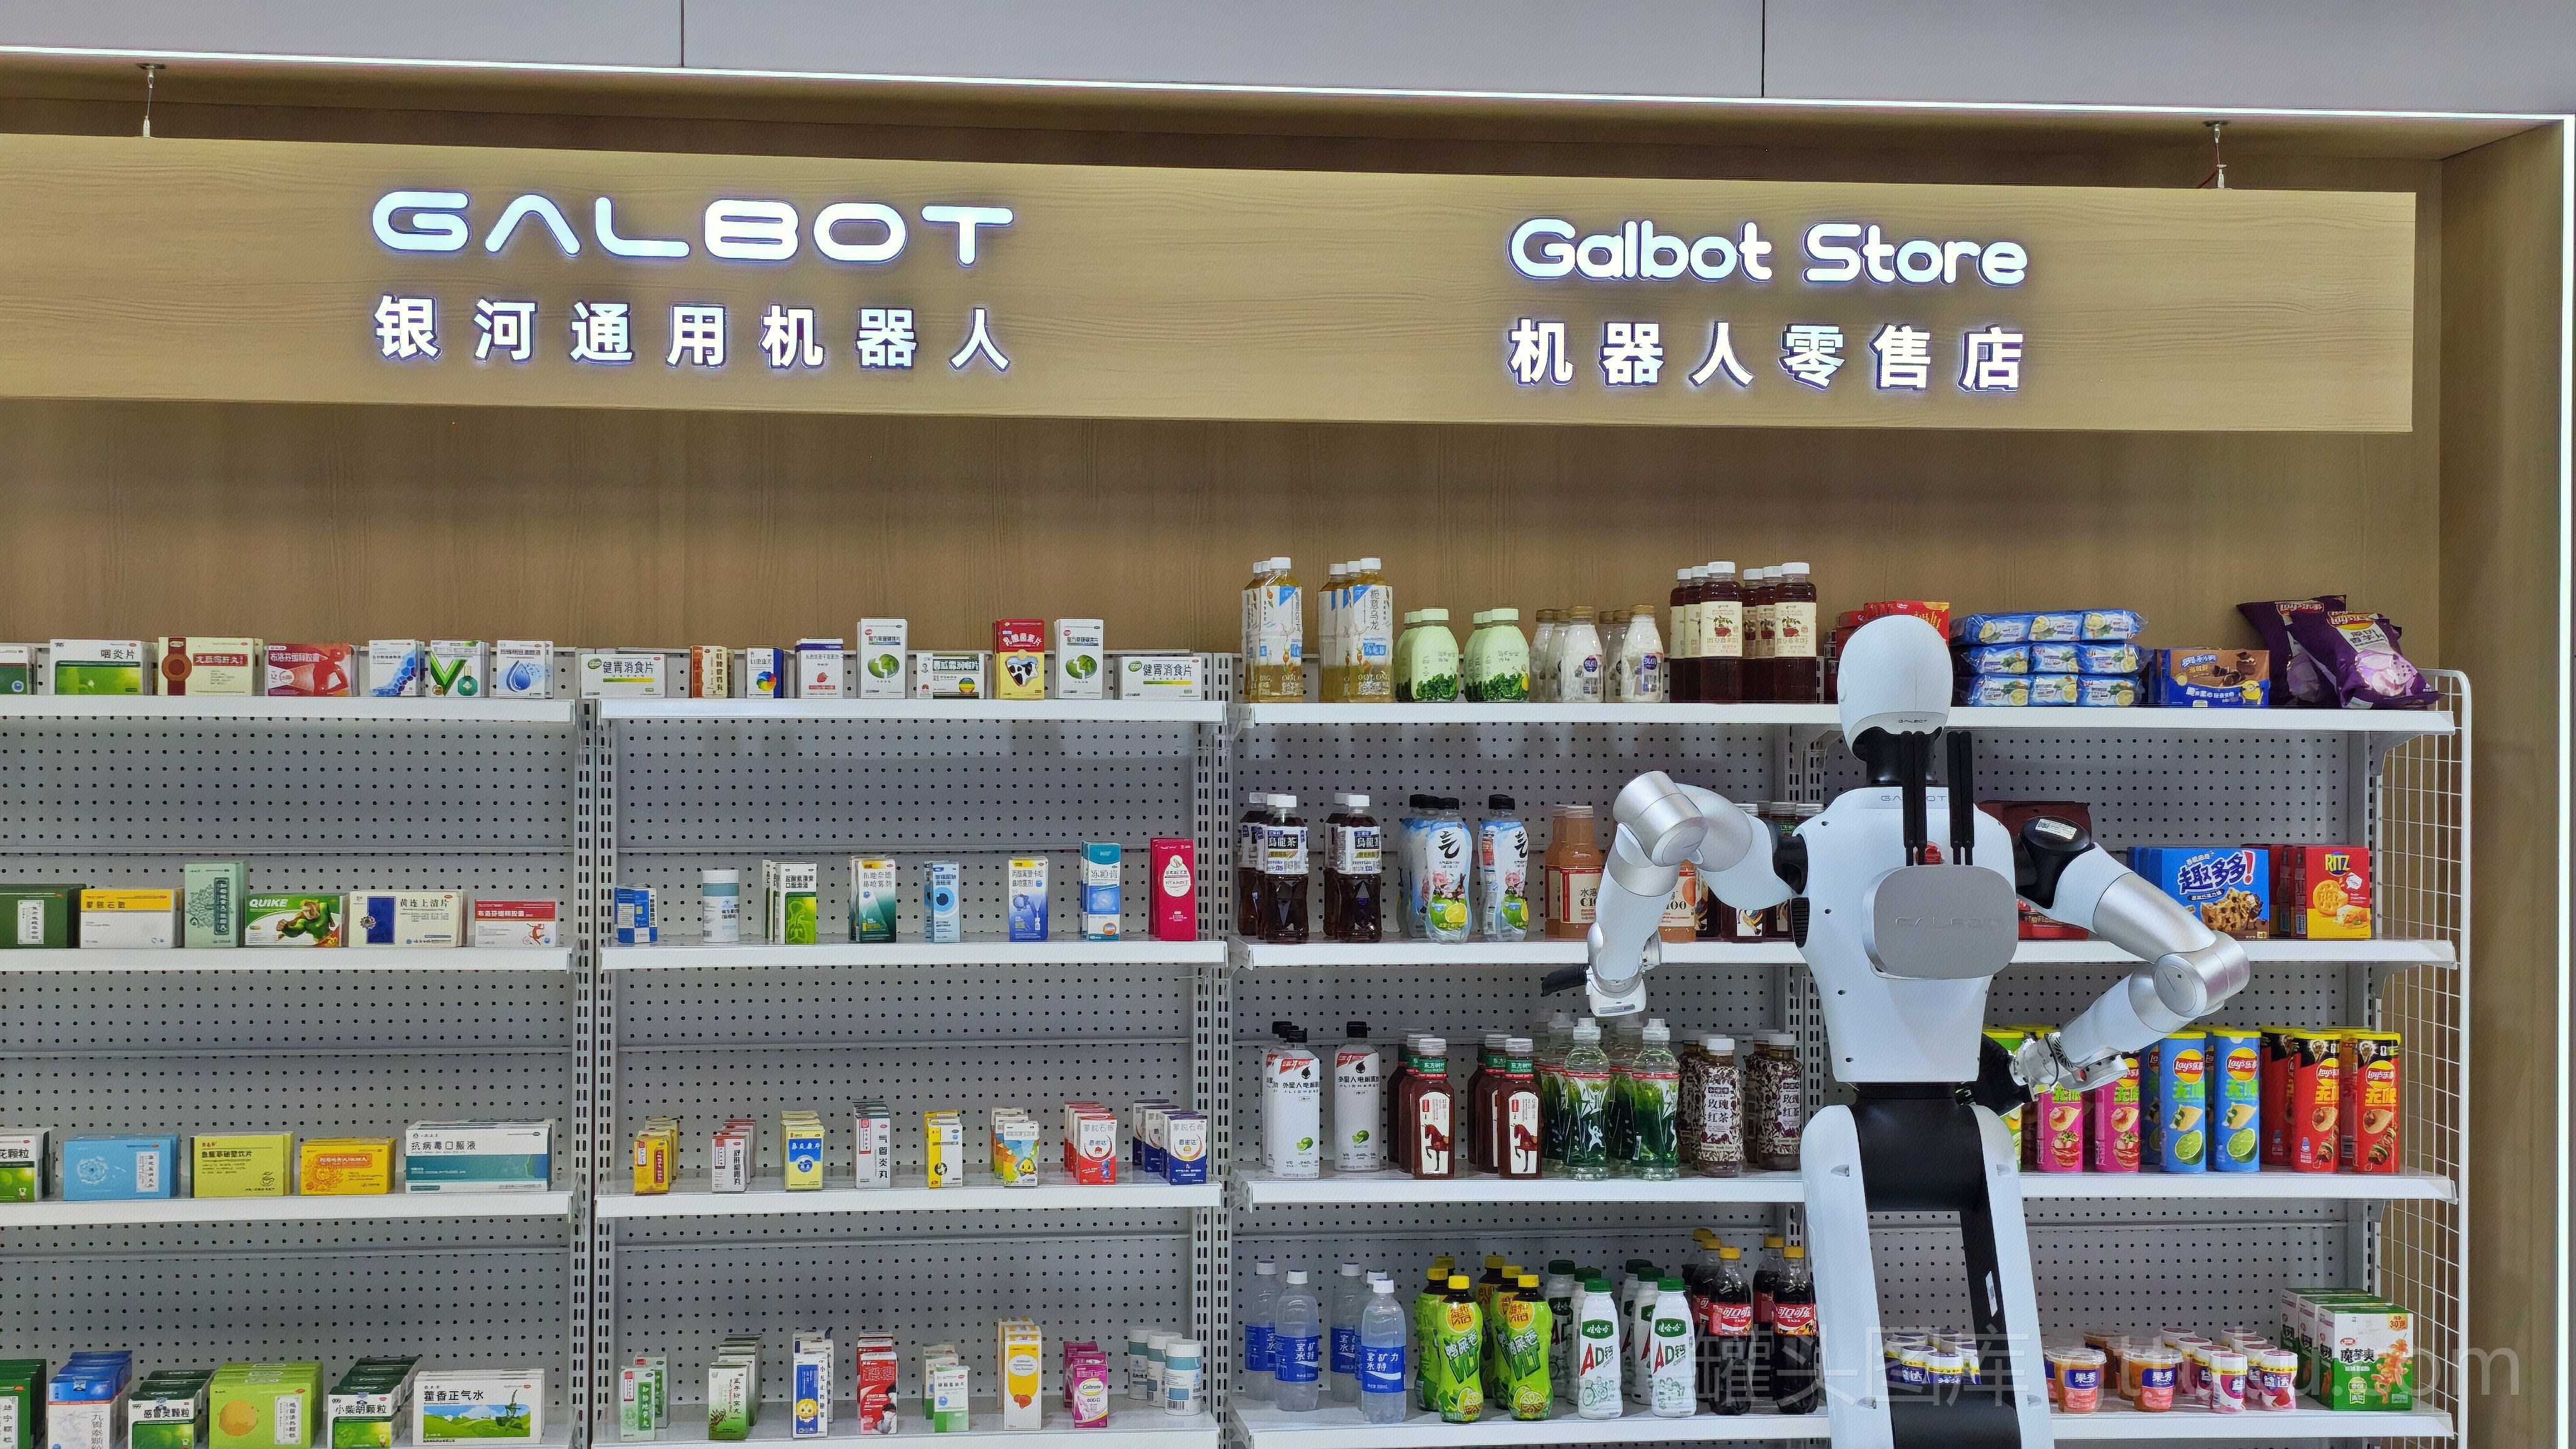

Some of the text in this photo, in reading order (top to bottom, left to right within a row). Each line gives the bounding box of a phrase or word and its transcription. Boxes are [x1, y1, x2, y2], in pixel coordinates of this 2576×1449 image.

[373, 191, 1014, 266] GALBOT
[1509, 218, 2028, 286] Galbot Store
[375, 294, 1010, 370] 银河通用机器人
[1508, 318, 2024, 391] 机器人零售店
[602, 660, 654, 674] 健胃消食片
[1143, 663, 1192, 677] 健胃消食片
[2325, 854, 2351, 871] RITZ
[249, 899, 288, 908] QUIKE
[1708, 1099, 1729, 1110] 玫瑰
[1707, 1113, 1729, 1123] 红茶
[411, 1141, 477, 1151] 抗病毒口服液
[1367, 1352, 1399, 1363] 宝矿力
[1367, 1362, 1387, 1372] 水特
[424, 1389, 484, 1402] 藿香正气水
[143, 1407, 191, 1419] 感冒灵颗粒
[335, 1404, 387, 1415] 小柴胡颗粒
